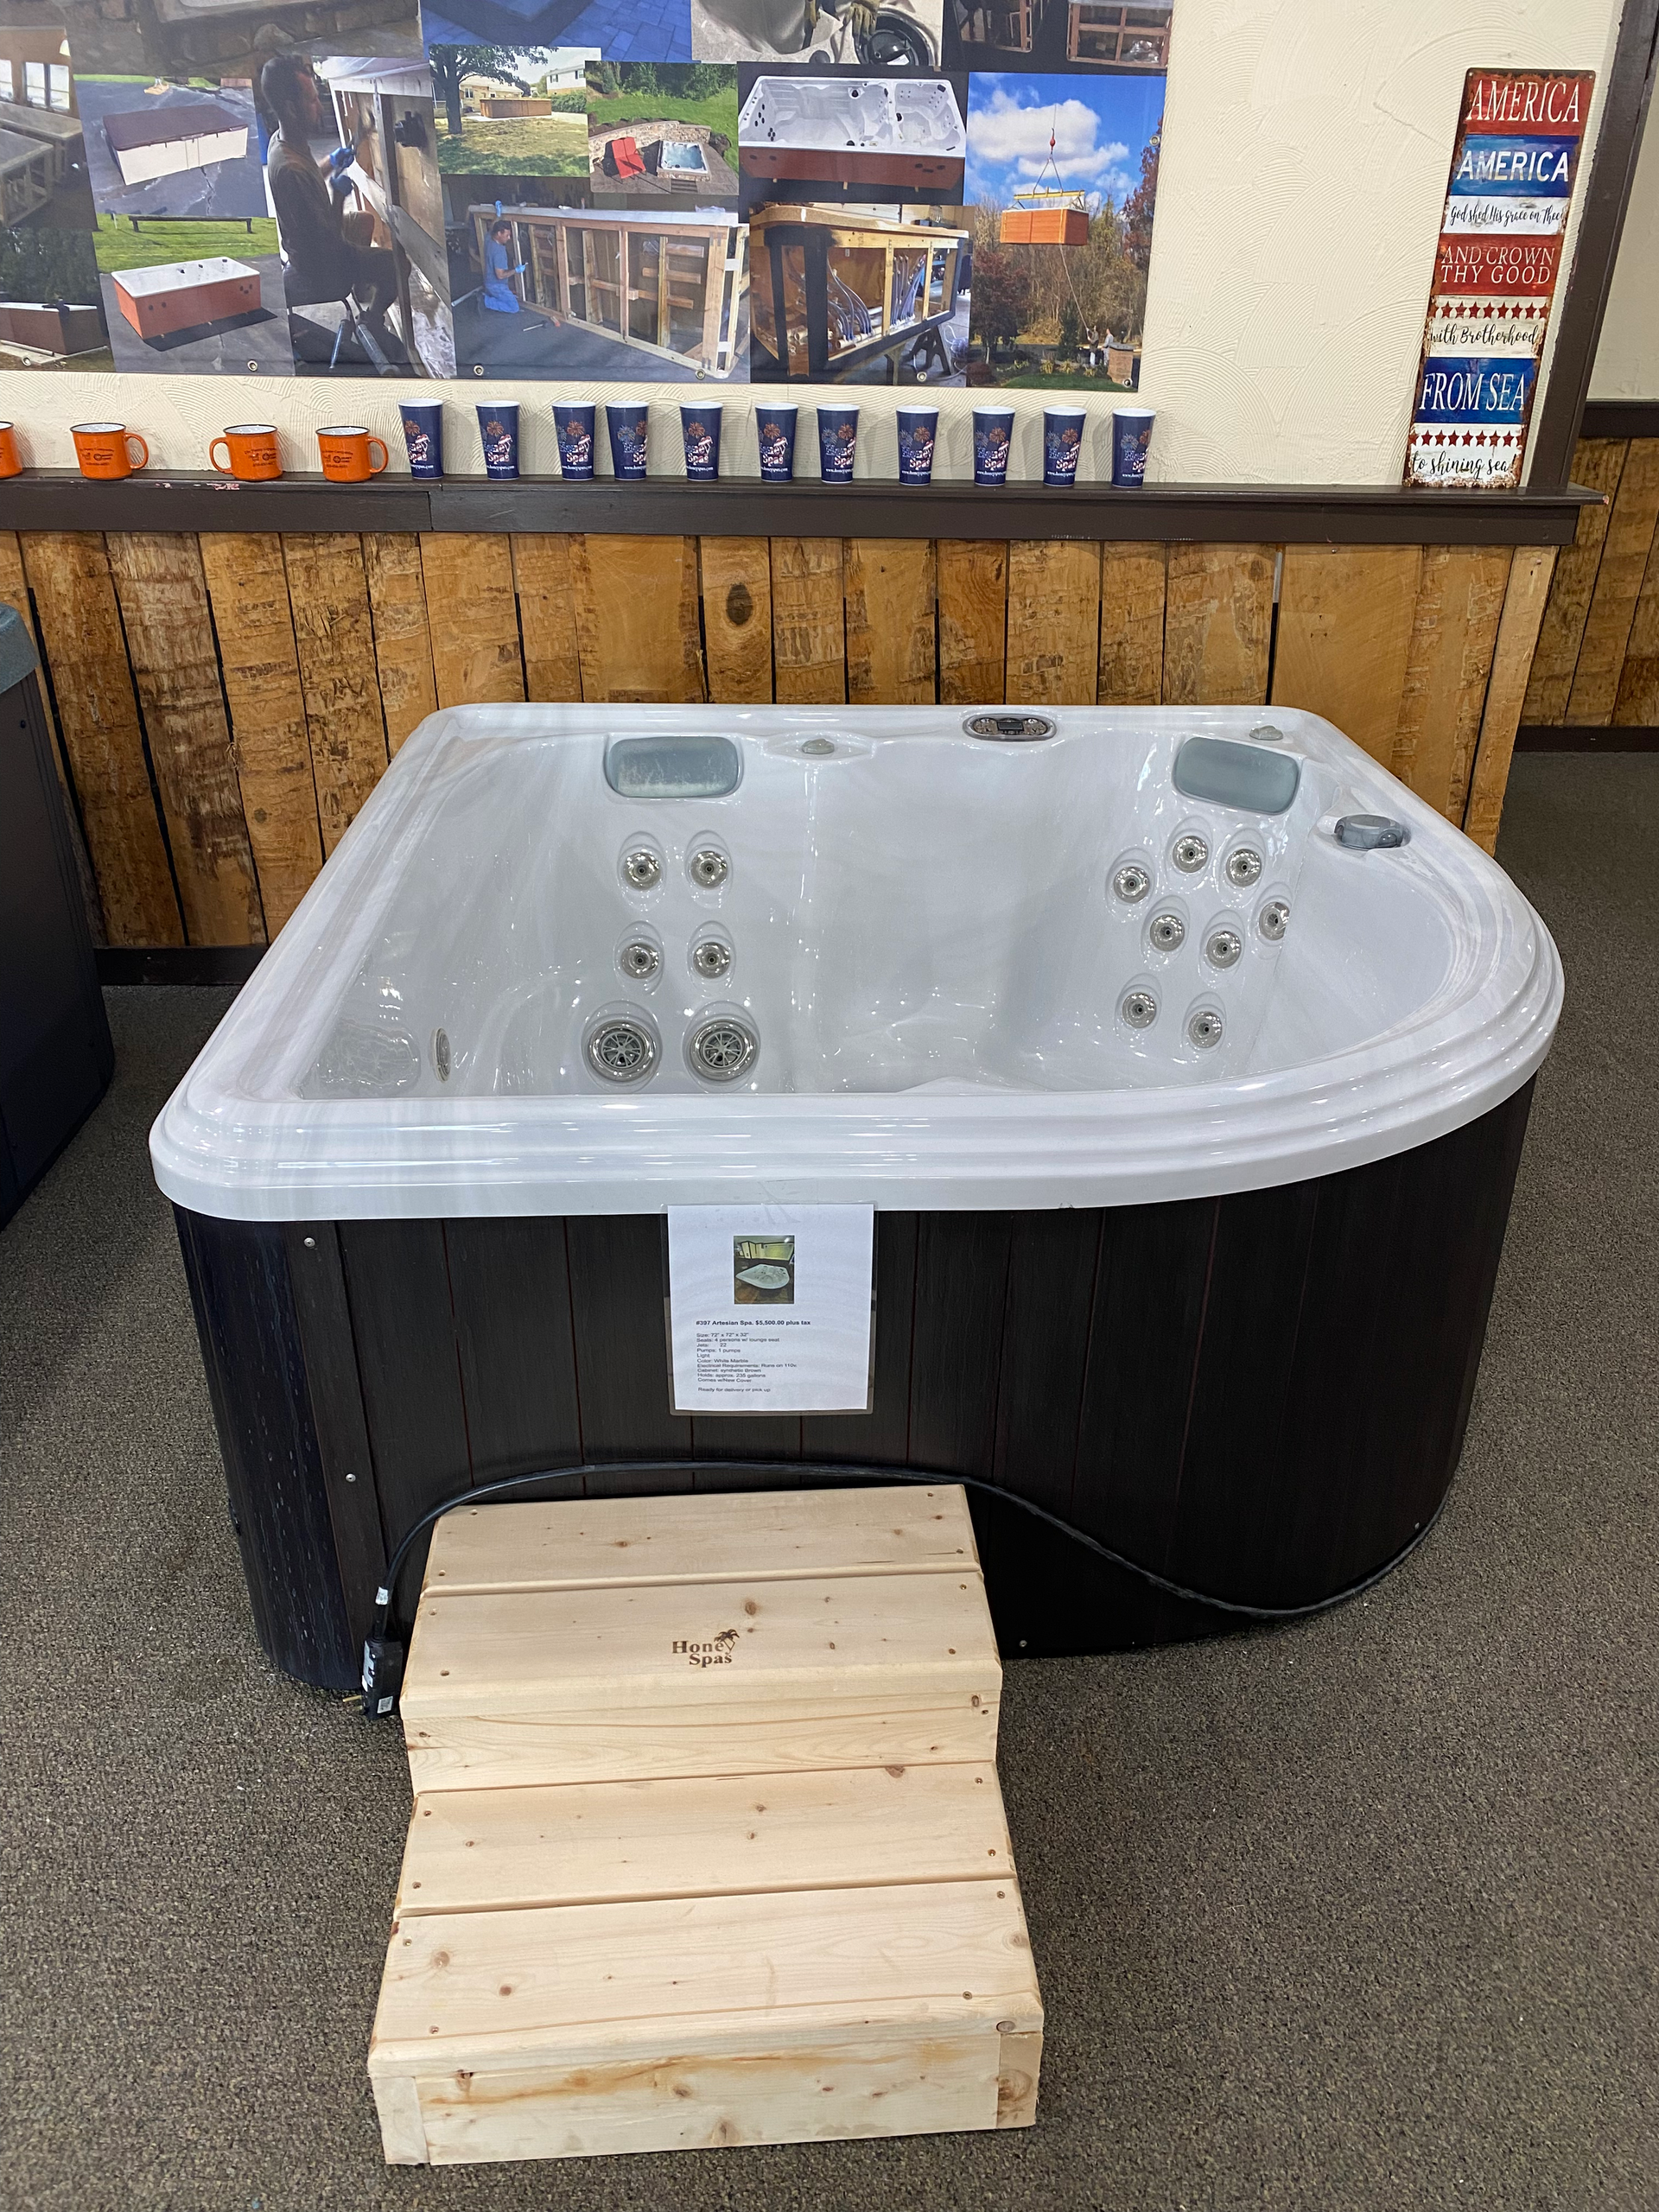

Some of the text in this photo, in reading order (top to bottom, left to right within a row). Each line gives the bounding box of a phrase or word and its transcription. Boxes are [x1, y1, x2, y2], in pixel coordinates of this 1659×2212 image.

[1466, 79, 1580, 123] AMERICA
[1456, 150, 1568, 182] AMERICA
[1450, 203, 1468, 226] God
[1469, 203, 1490, 223] shed
[1490, 206, 1503, 222] His
[1503, 209, 1527, 227] grace
[1529, 211, 1541, 223] on
[1442, 245, 1555, 265] AND CROWN
[1441, 265, 1550, 284] THY GOOD
[1431, 323, 1538, 346] with Brotherhood
[1419, 372, 1524, 411] FROM SEA
[488, 451, 510, 465] Spas
[566, 452, 588, 465] Spas
[688, 453, 709, 466] Spas
[763, 454, 784, 467] Spas
[984, 458, 1007, 471] Spas
[1412, 450, 1427, 473] to
[1430, 450, 1484, 480] shining
[689, 1653, 733, 1668] Spas
